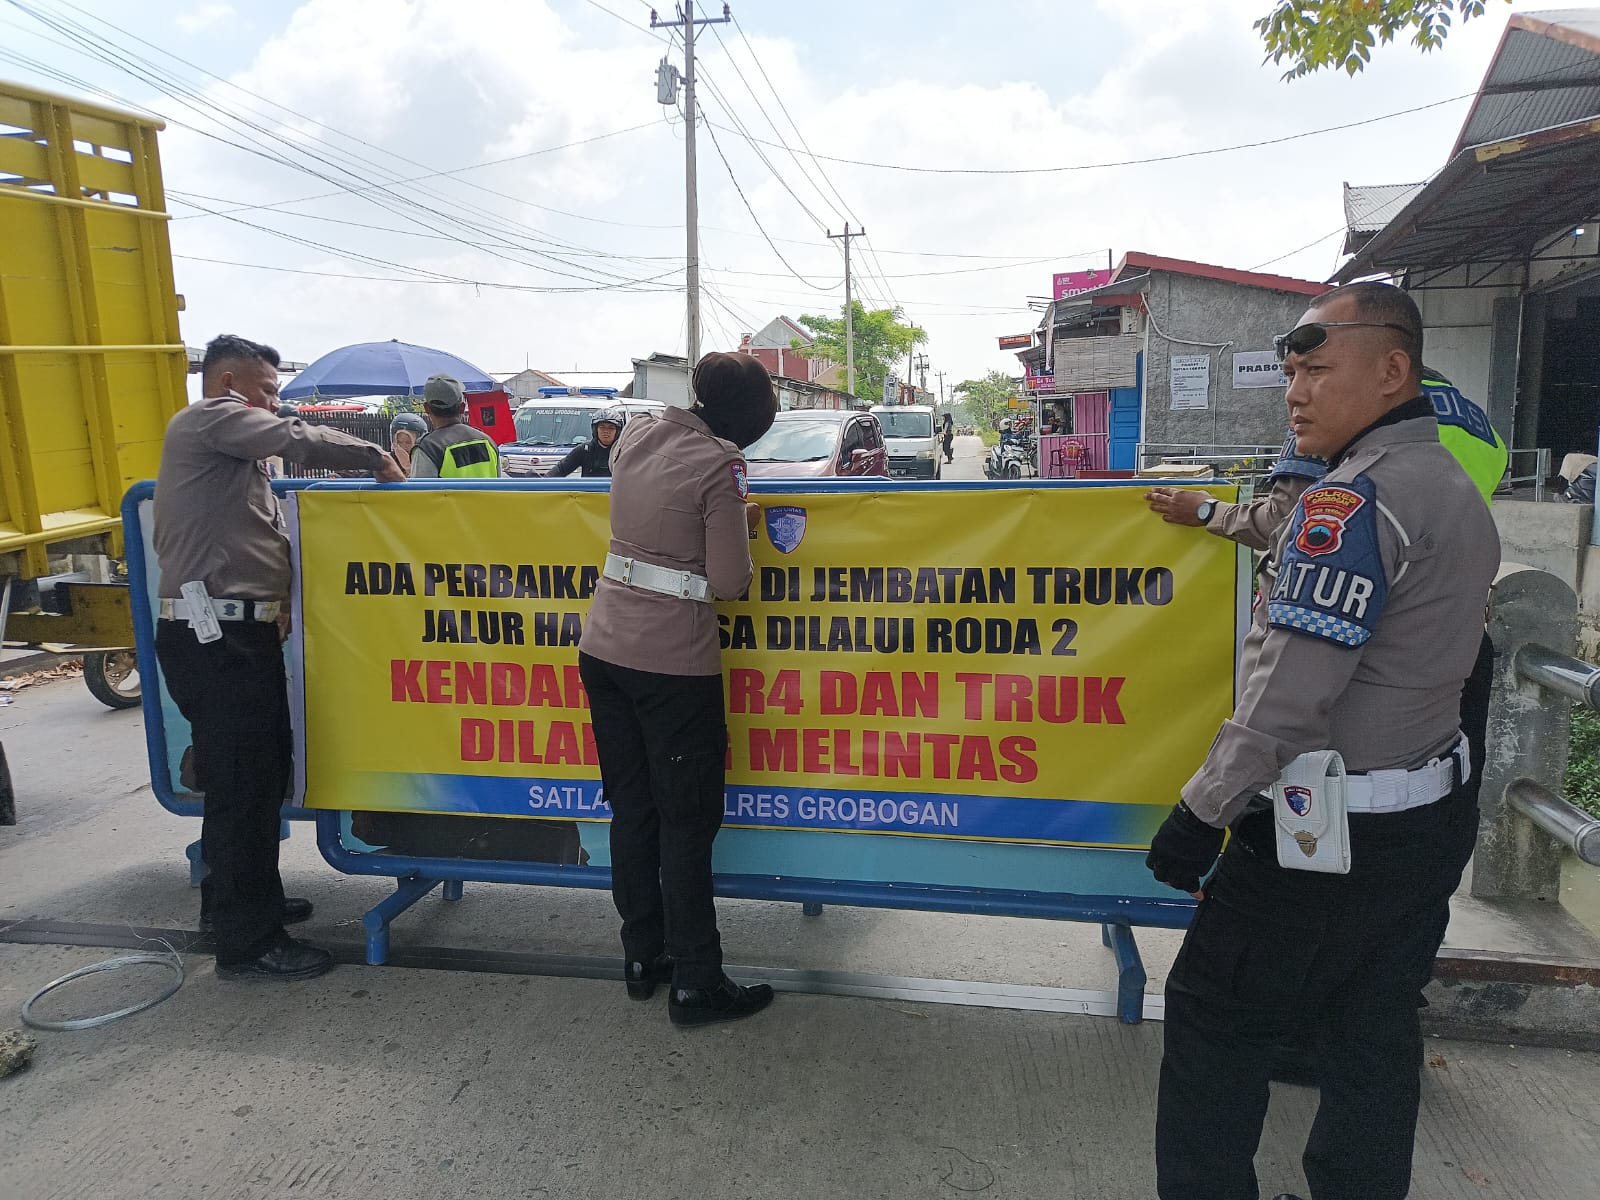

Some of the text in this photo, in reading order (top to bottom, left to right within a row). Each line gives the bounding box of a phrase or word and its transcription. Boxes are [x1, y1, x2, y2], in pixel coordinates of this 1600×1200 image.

[1429, 391, 1490, 437] OLISI
[1307, 491, 1357, 504] POLRES
[345, 562, 1174, 606] ADA PERBAIKA DI JEMBATAN TRUKO
[1271, 562, 1374, 619] ATUR
[422, 609, 1078, 657] JALUR HA SA DILALUI RODA 2
[390, 659, 1126, 725] KENDAR R4 DAN TRUK
[460, 718, 601, 766] DILA
[749, 728, 1039, 784] MELINTAS
[528, 785, 959, 828] SATLA LRES GROBOGAN
